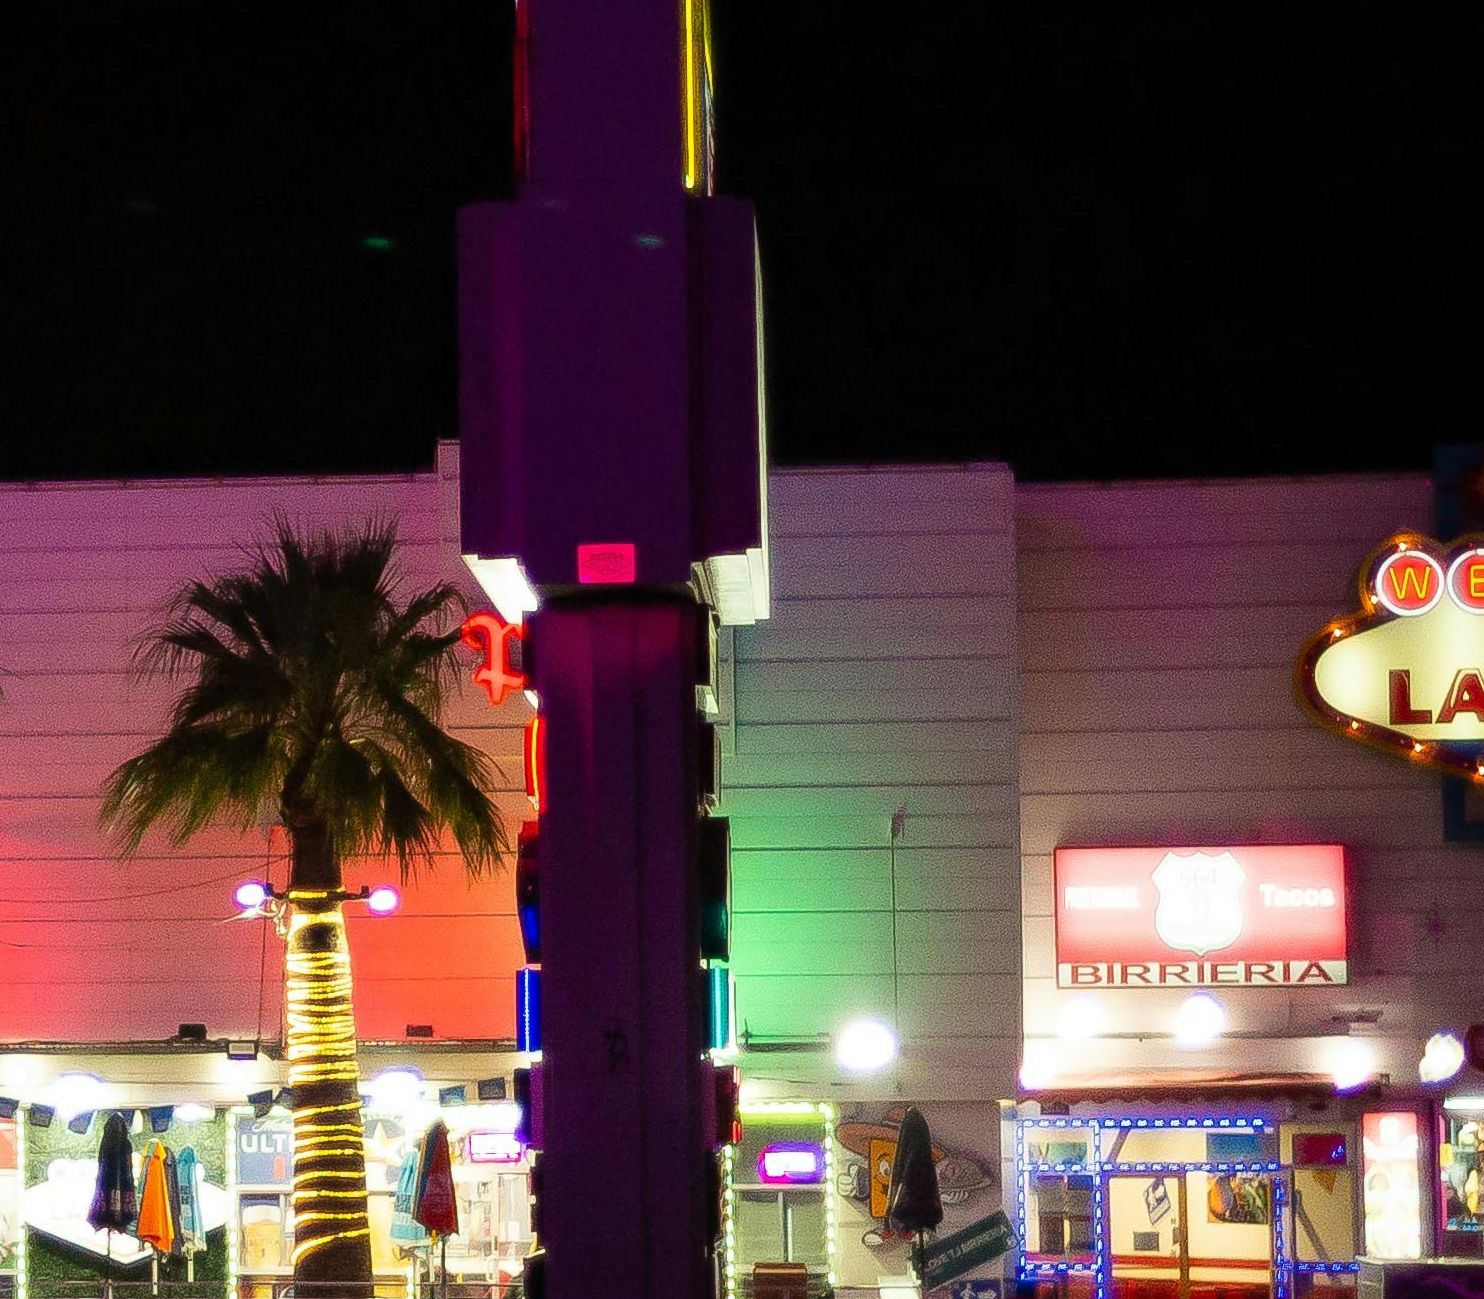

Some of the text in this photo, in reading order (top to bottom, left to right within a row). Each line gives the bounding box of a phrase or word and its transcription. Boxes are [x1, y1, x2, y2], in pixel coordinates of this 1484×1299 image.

[1258, 882, 1336, 908] Tacos
[1069, 962, 1334, 986] BIRRIERIA
[240, 1132, 294, 1154] ULT
